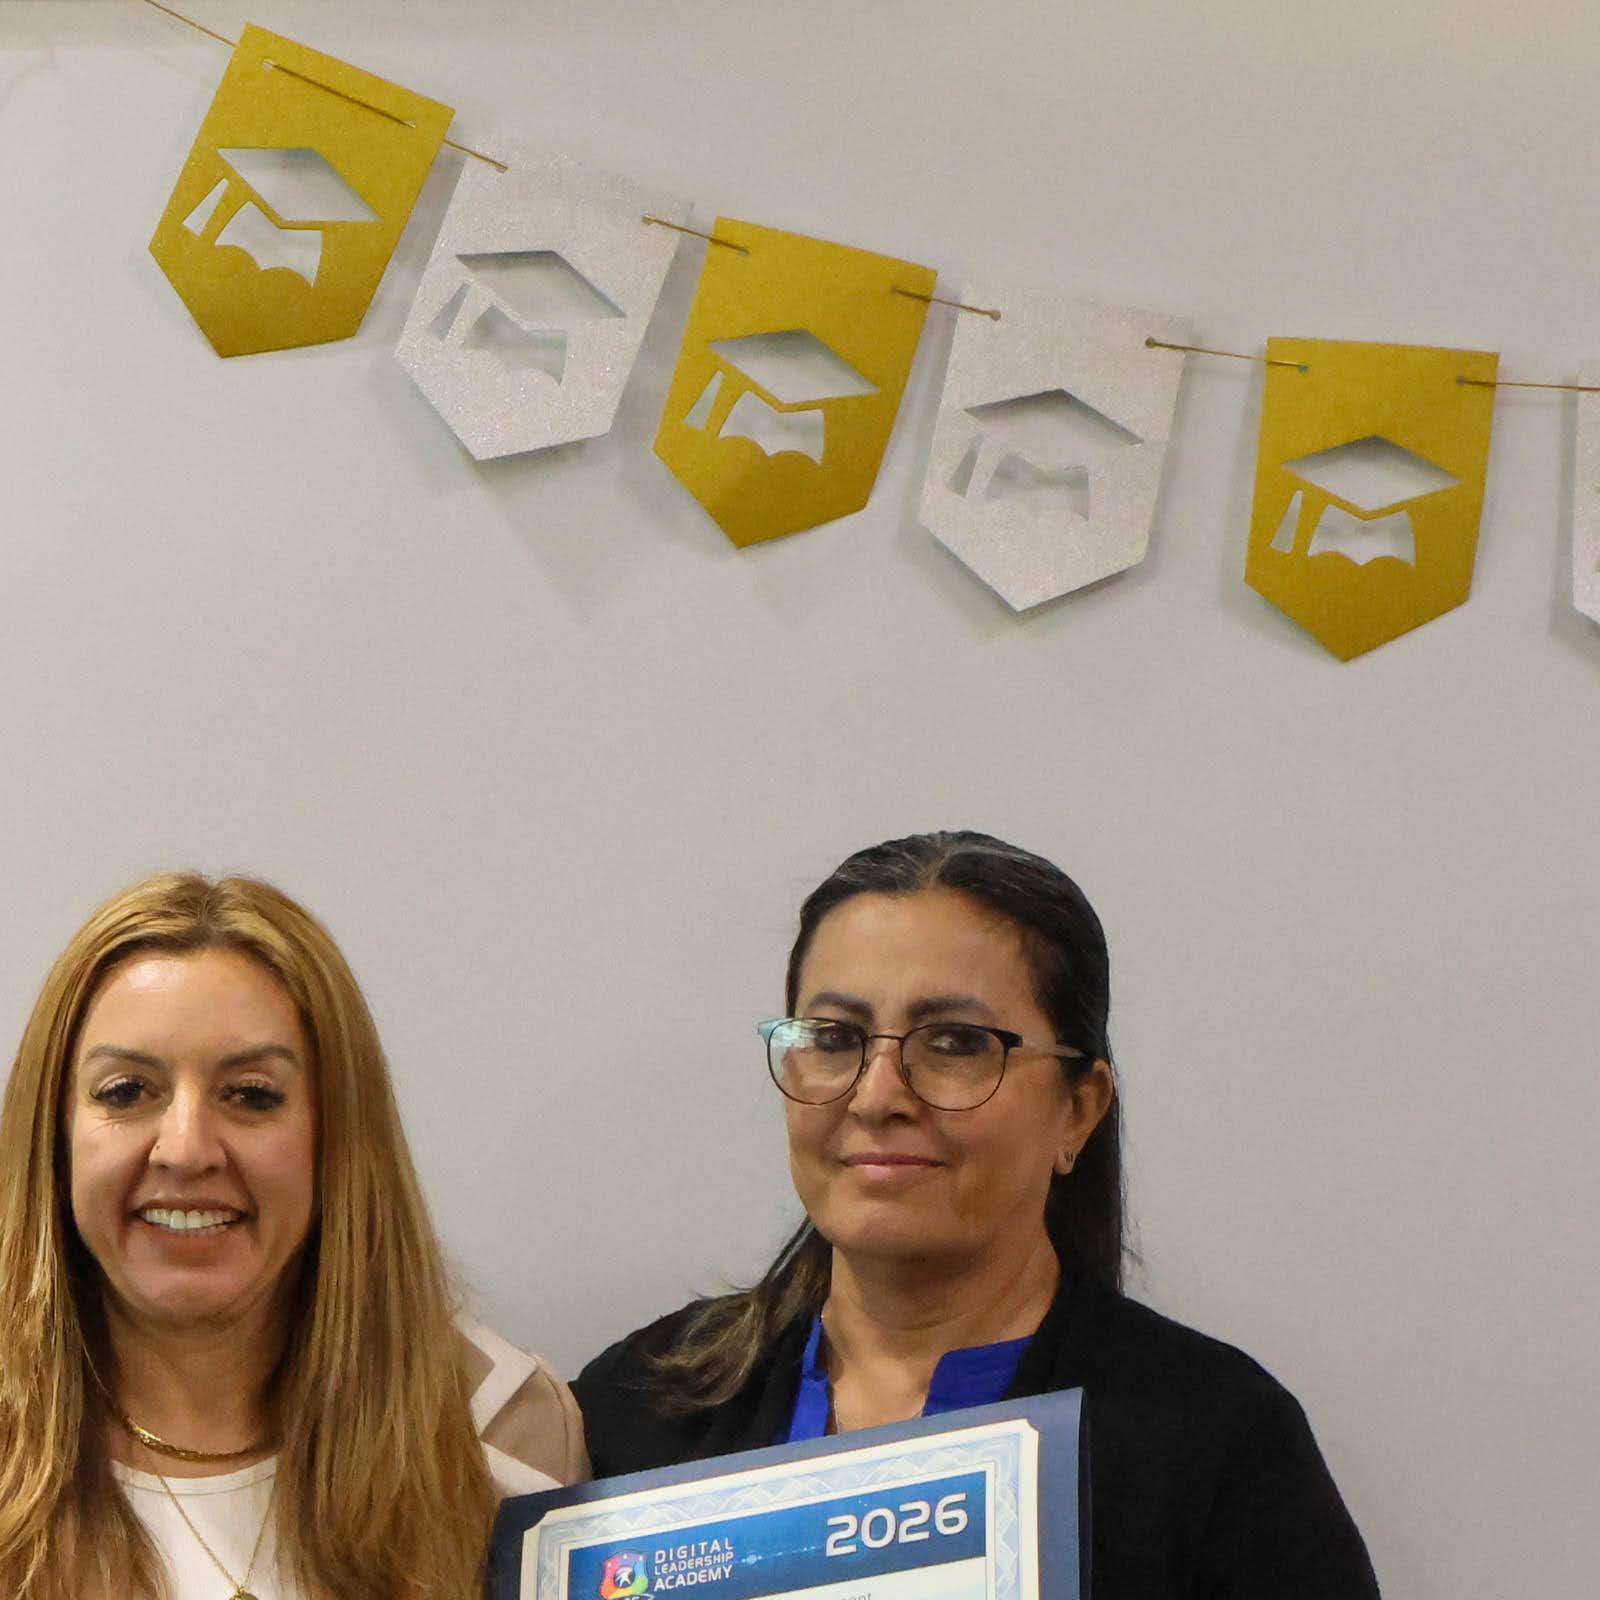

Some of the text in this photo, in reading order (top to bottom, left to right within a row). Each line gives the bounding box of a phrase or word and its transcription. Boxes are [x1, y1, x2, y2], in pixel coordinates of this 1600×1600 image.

[826, 1493, 968, 1557] 2026
[655, 1537, 733, 1564] DIGITAL
[655, 1552, 734, 1575] LEADERSHIP
[654, 1564, 732, 1592] ACADEMY
